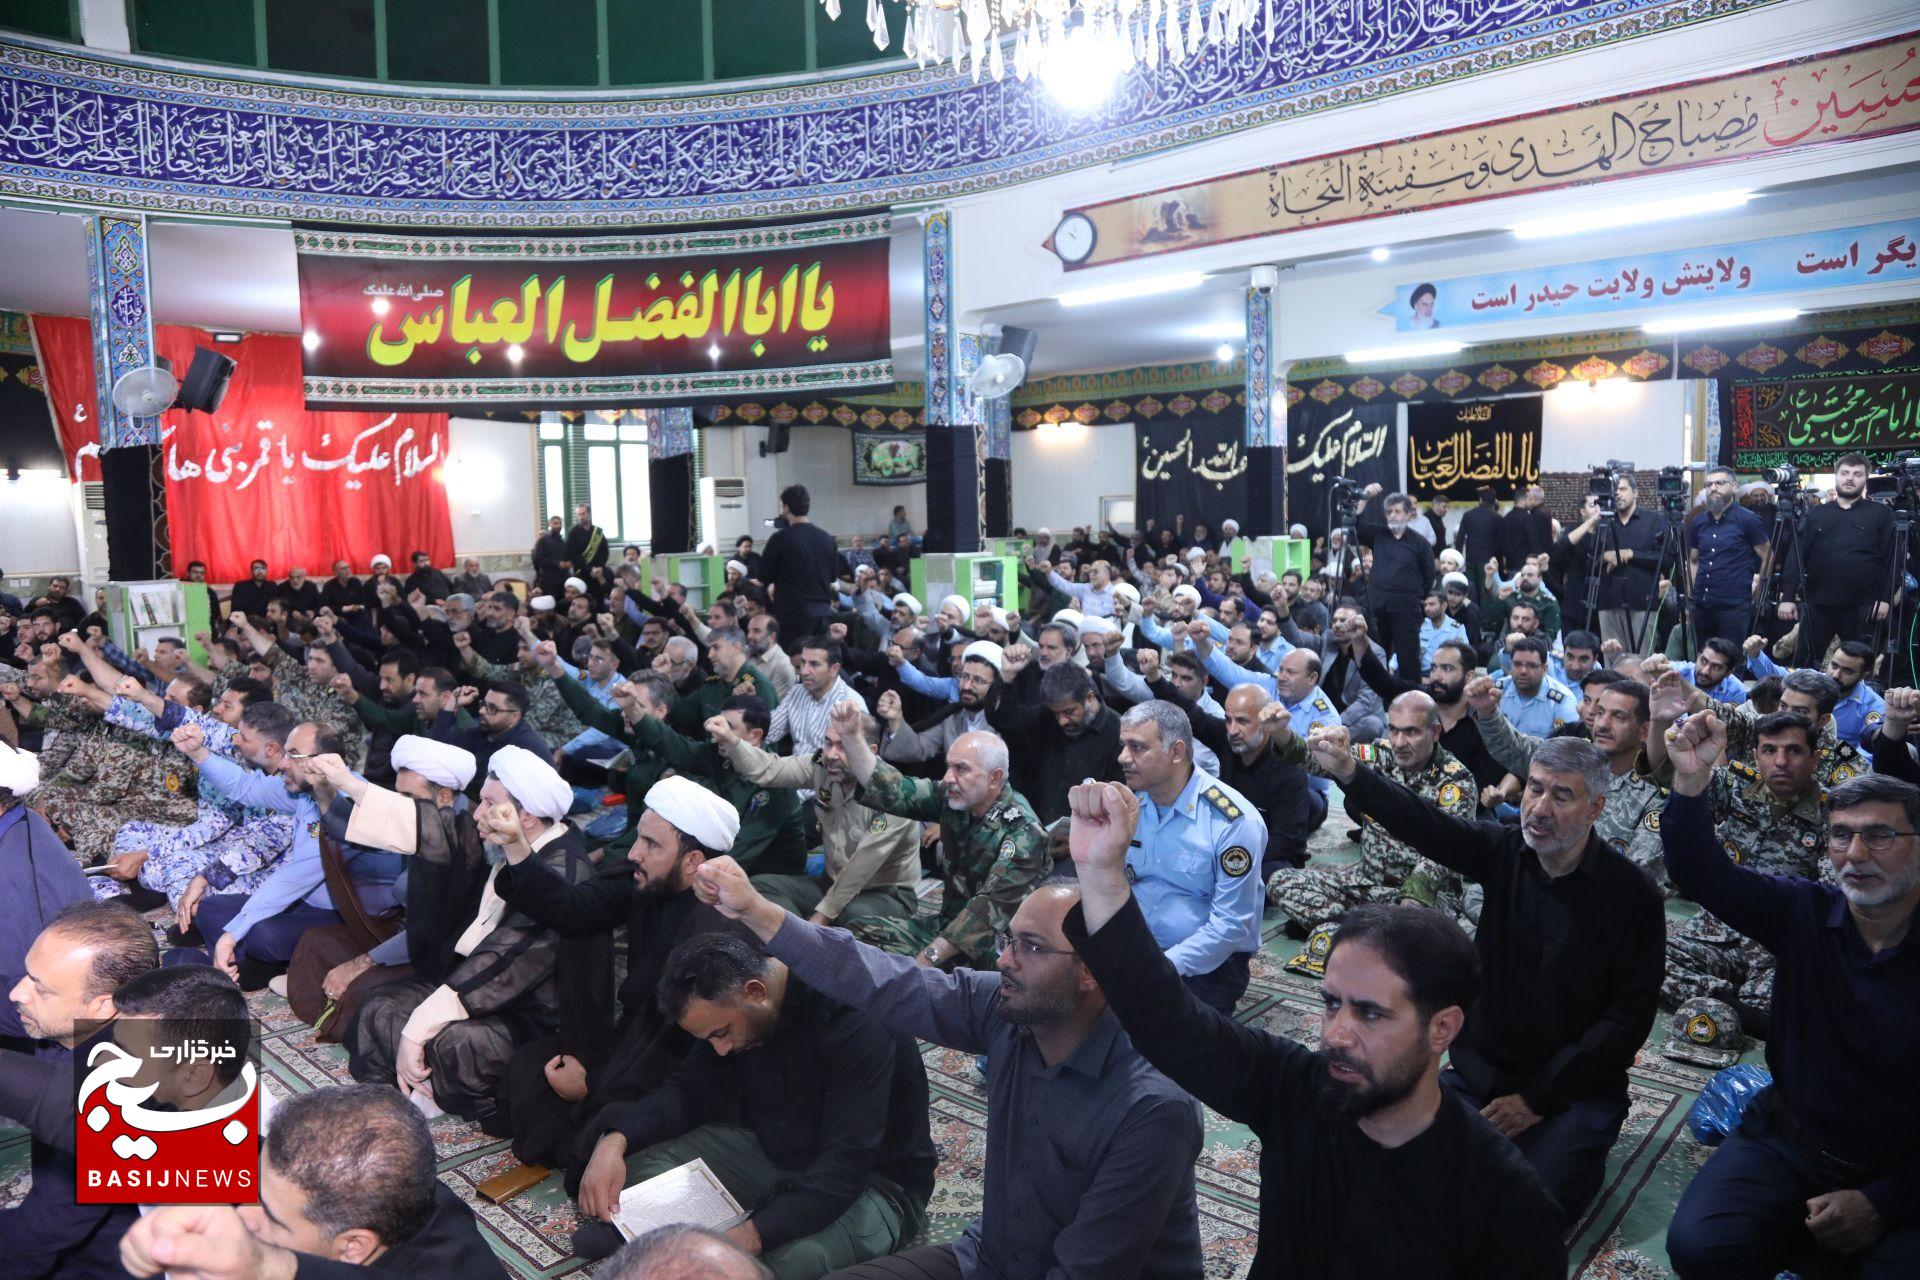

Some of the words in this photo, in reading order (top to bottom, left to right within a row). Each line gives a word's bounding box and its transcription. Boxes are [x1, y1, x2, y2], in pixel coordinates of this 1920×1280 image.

[1587, 268, 1655, 300] ولایت
[1661, 256, 1752, 297] ولایتش
[1796, 241, 1860, 275] است
[366, 273, 566, 366] العباس
[800, 261, 835, 352] یا
[1471, 283, 1518, 311] است
[1523, 281, 1580, 312] حیدر
[205, 423, 249, 483] بنی
[235, 420, 273, 491] قمر
[277, 432, 295, 485] یا
[1141, 428, 1194, 480] الحسین
[1287, 408, 1354, 484] علیک
[1340, 420, 1388, 478] السلام
